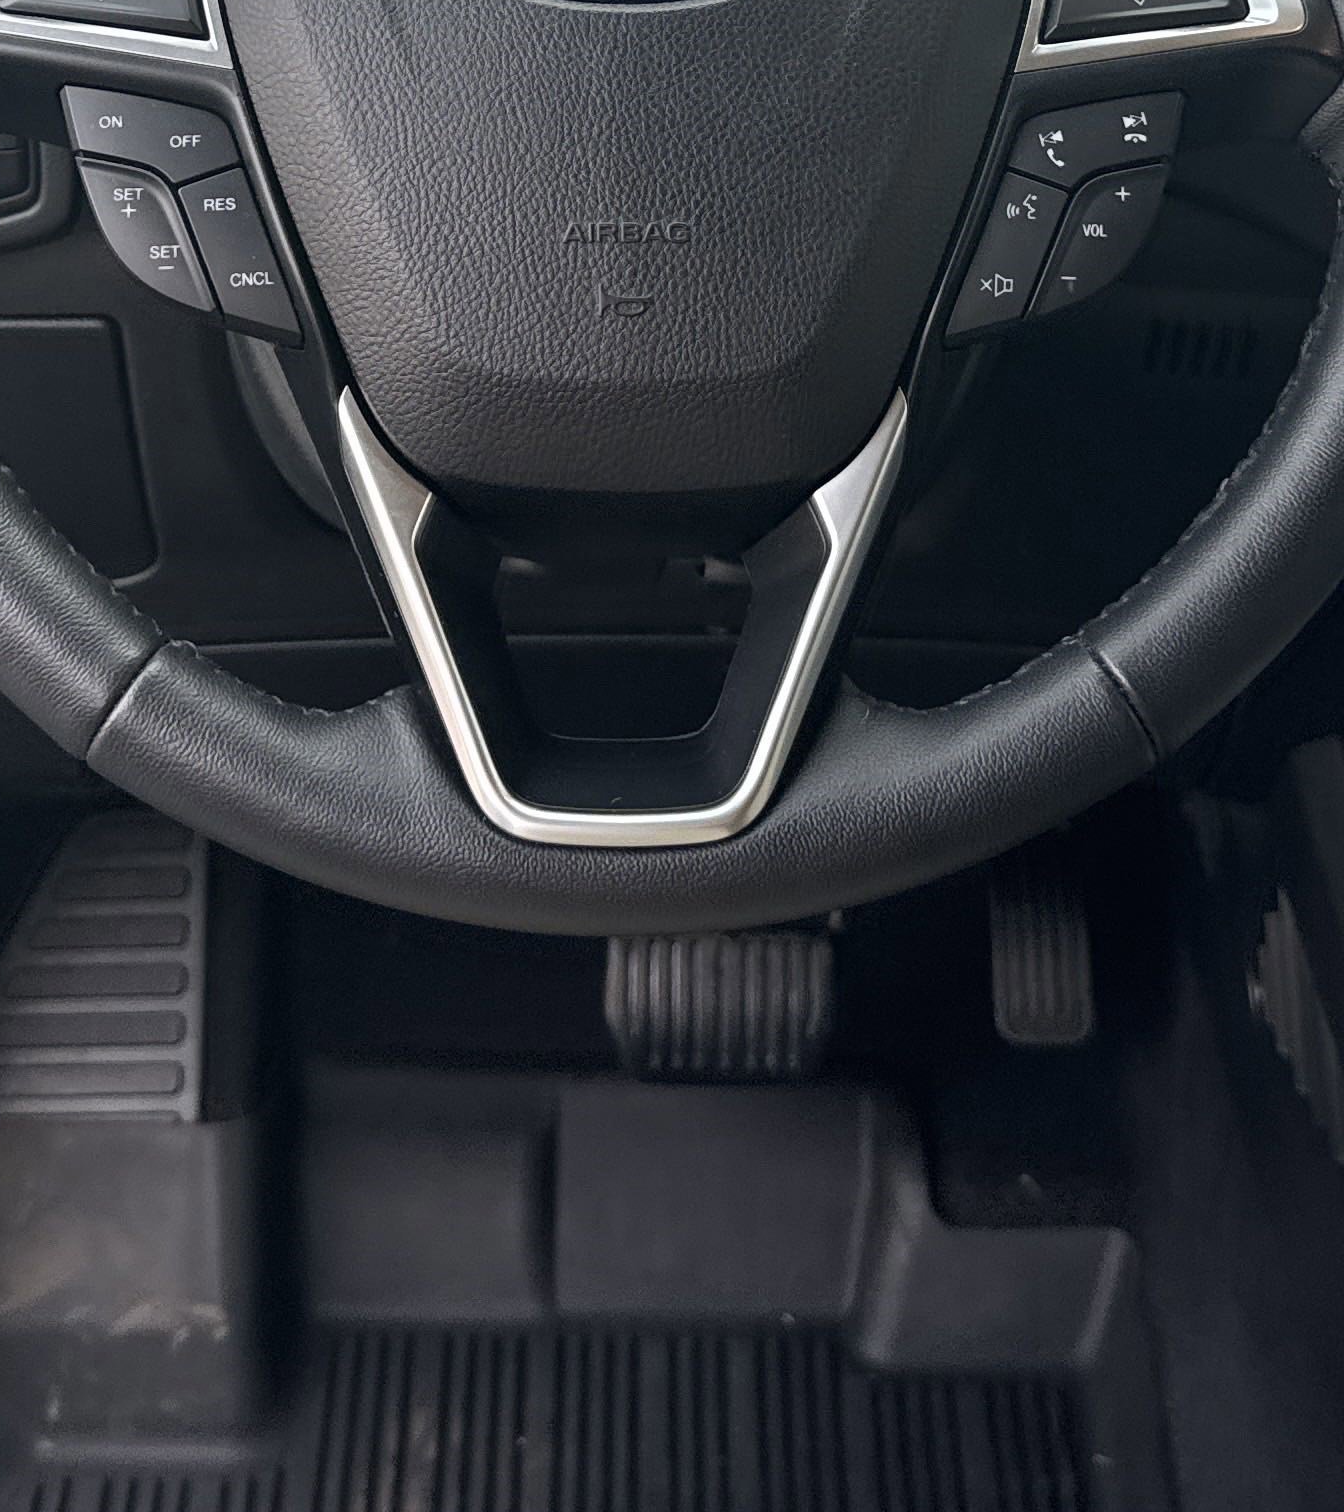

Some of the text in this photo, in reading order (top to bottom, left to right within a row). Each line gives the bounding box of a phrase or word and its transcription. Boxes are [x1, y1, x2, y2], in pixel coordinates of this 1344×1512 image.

[98, 115, 124, 129] ON
[169, 134, 202, 148] OFF
[113, 187, 143, 202] SET
[203, 197, 237, 212] RES
[562, 220, 692, 244] AIRBAG
[1082, 223, 1108, 238] VOL
[149, 244, 180, 259] SET
[229, 271, 275, 287] CNCL
